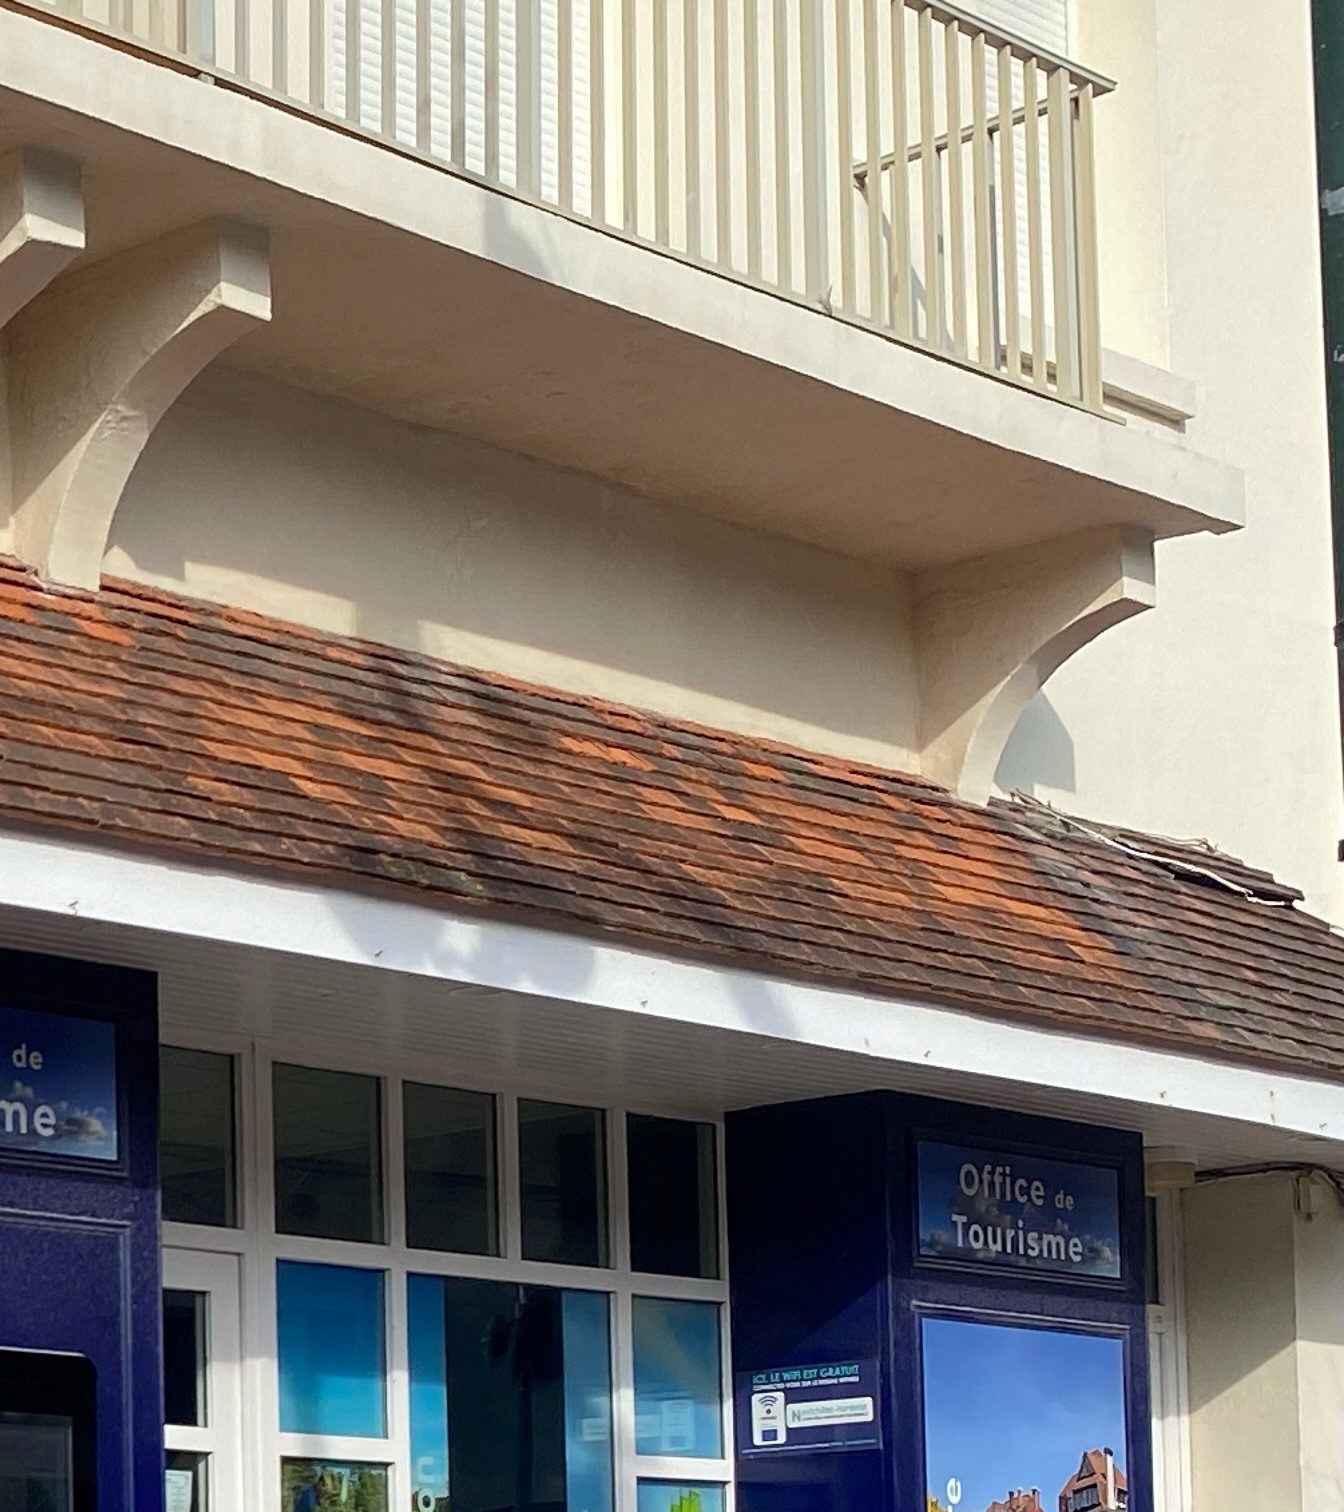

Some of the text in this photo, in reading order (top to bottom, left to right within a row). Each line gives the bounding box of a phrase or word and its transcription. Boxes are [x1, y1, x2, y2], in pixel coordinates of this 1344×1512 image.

[12, 1043, 44, 1070] de
[959, 1163, 1075, 1211] Office de
[951, 1213, 1083, 1263] Tourisme
